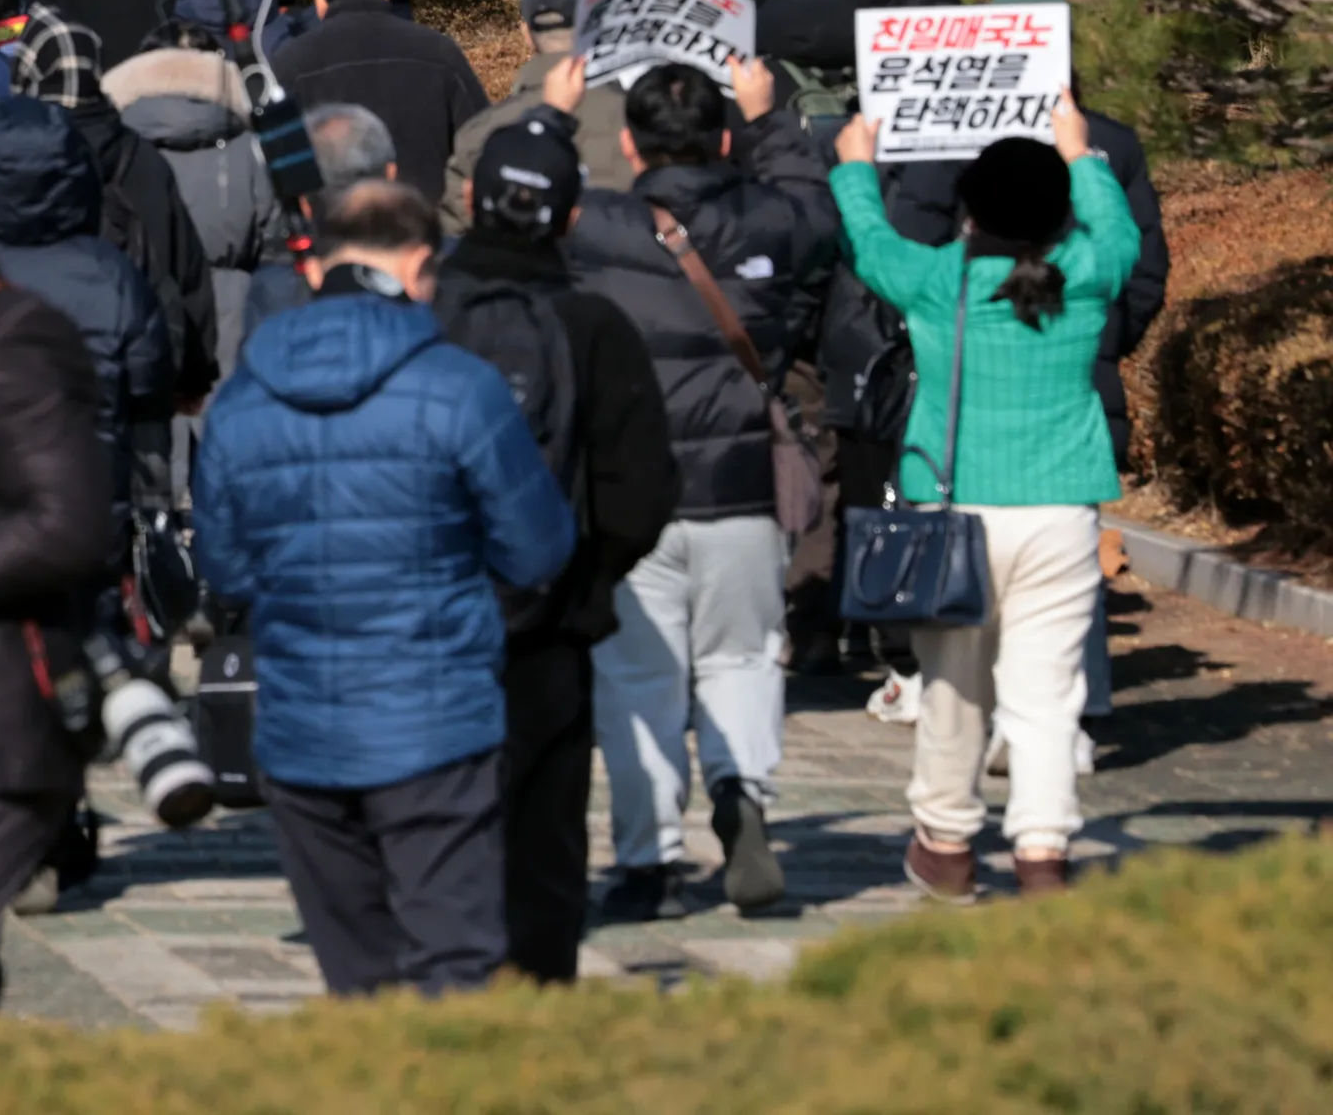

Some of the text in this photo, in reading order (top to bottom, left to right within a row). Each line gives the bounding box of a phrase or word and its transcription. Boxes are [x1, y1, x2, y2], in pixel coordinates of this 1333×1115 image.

[872, 15, 1053, 52] 친일매국노
[875, 53, 1030, 91] 윤석열을
[892, 94, 1060, 133] 탄핵하자!
